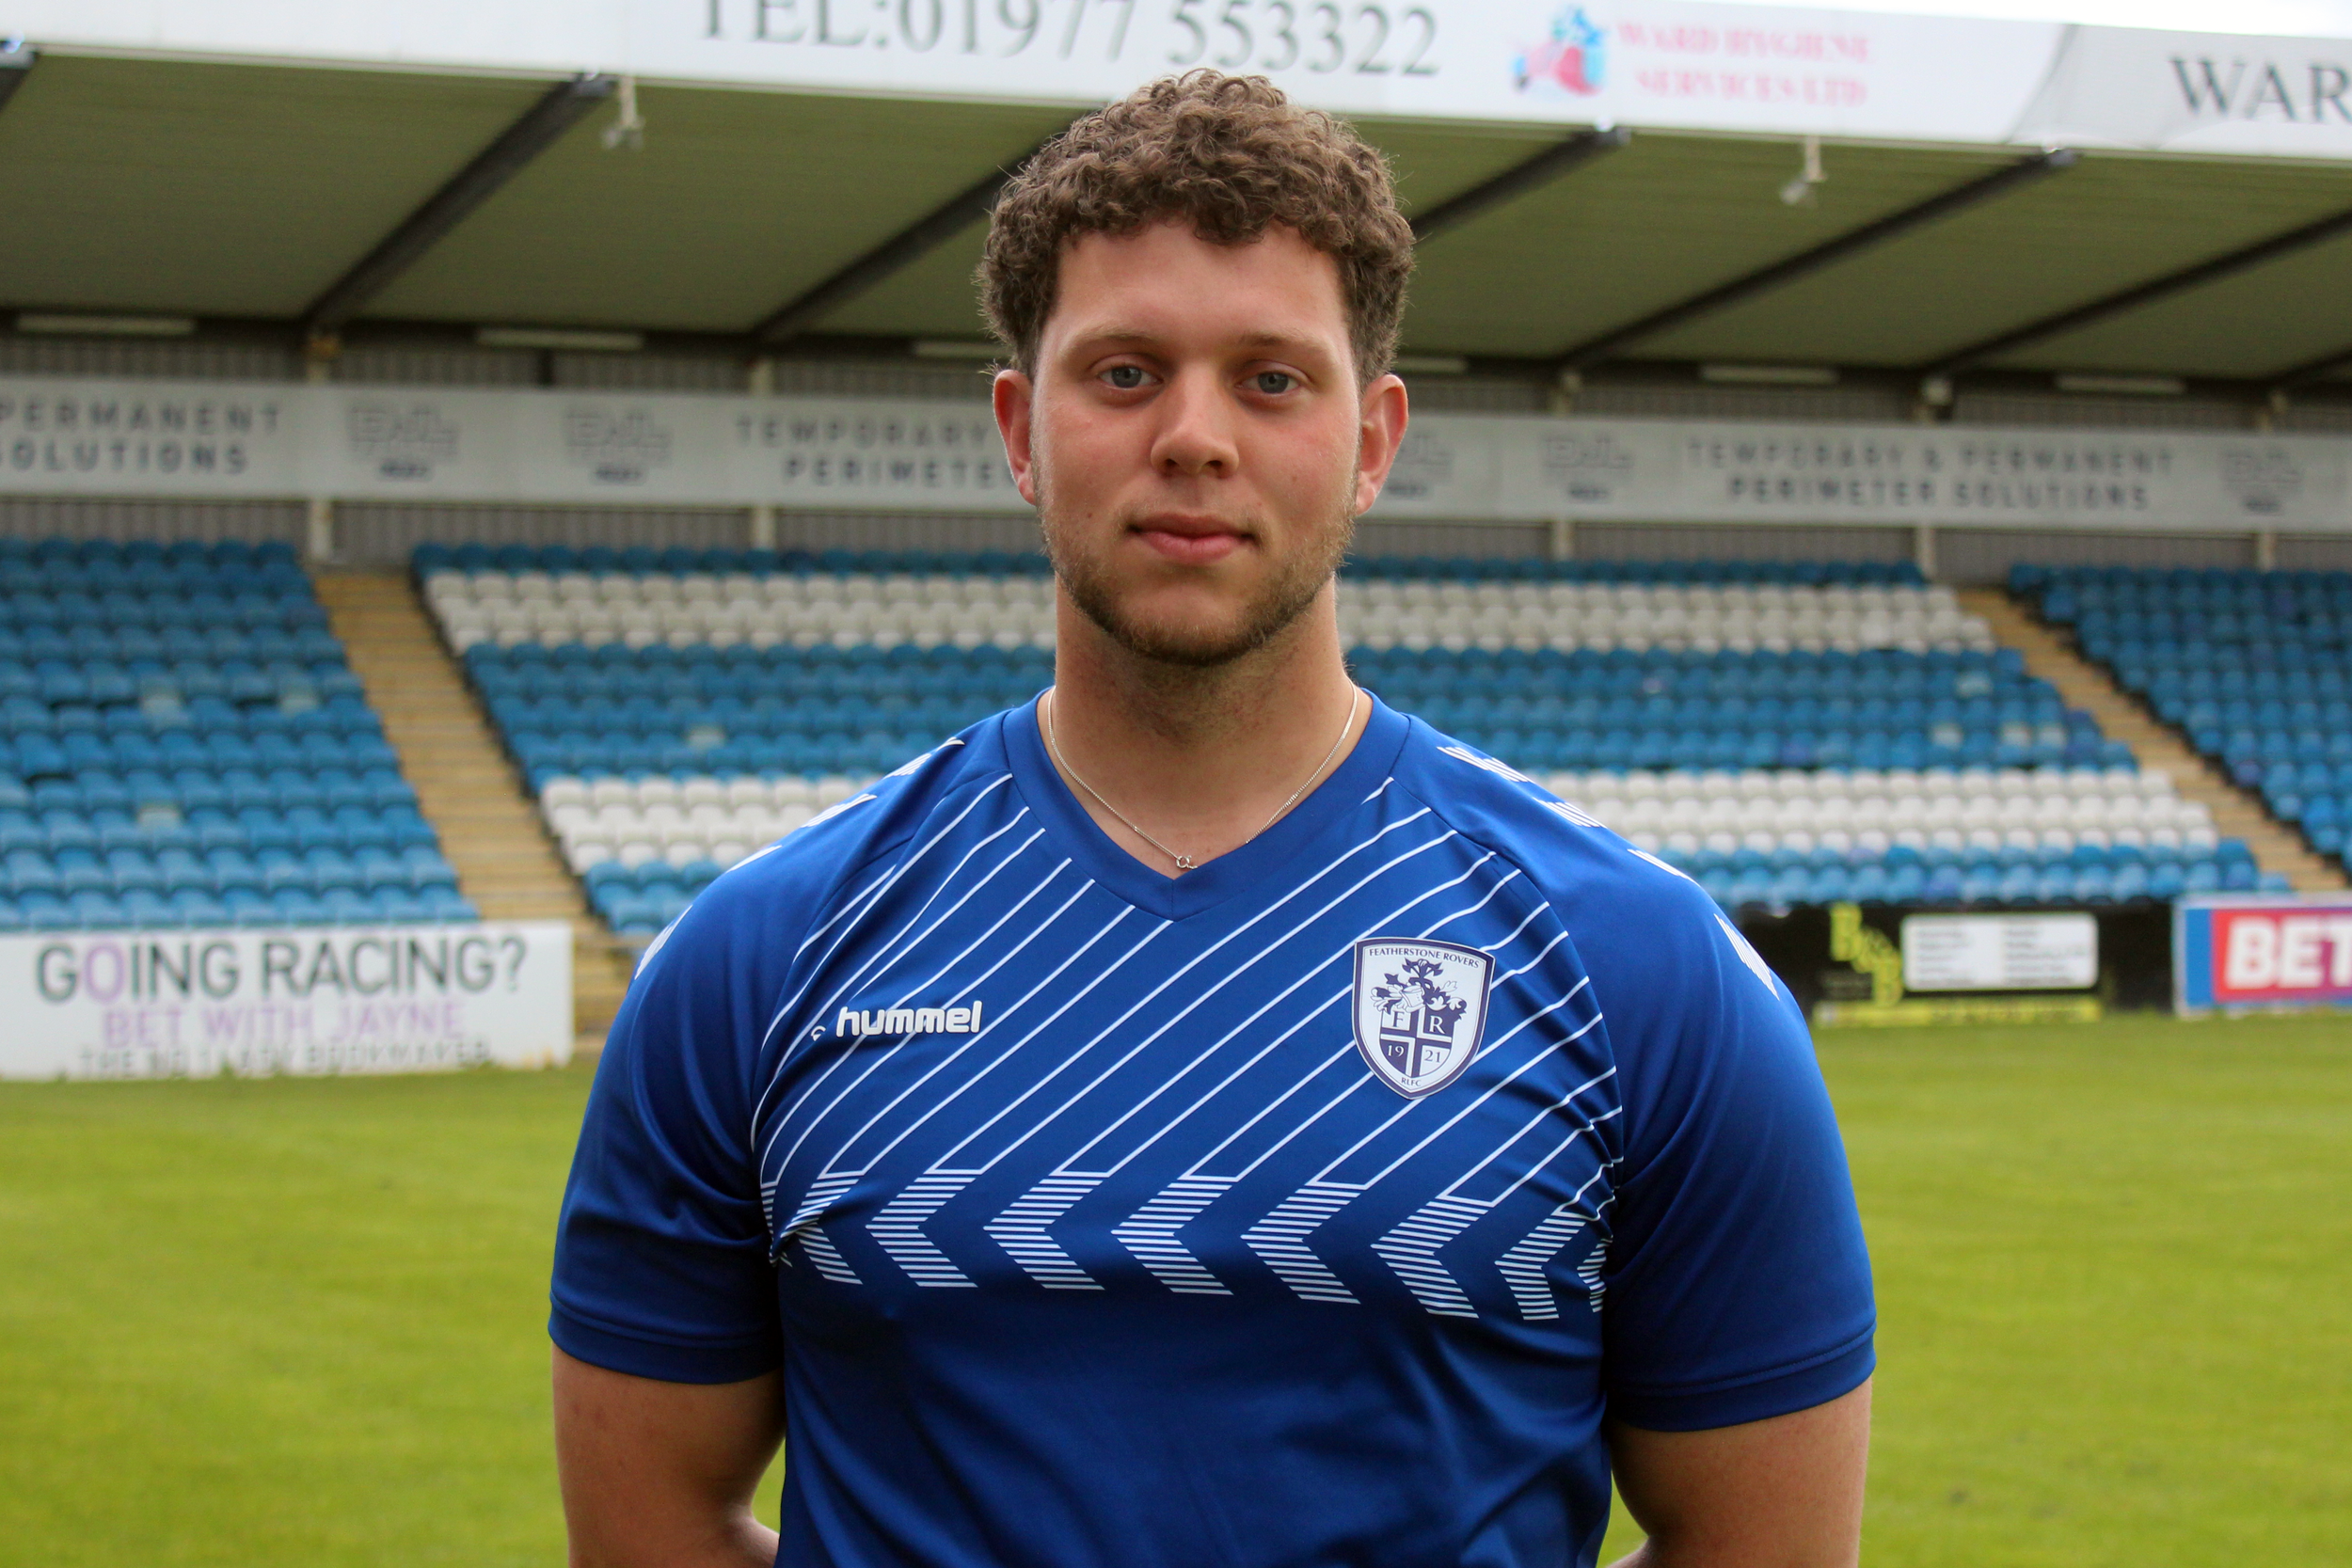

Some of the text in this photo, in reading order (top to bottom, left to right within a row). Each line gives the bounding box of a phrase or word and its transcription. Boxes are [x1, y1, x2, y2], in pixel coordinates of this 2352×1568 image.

[1167, 0, 1442, 75] 553322
[0, 436, 249, 474] OLUTIONS
[36, 935, 529, 1004] GOING RACING?
[1369, 947, 1480, 969] FEATHERSTONE ROVERS
[103, 999, 467, 1049] BET WITH JAYNE
[835, 1000, 982, 1037] hummel
[1392, 1010, 1446, 1035] F R
[1387, 1044, 1442, 1063] 19 21
[1401, 1076, 1422, 1087] RLFC
